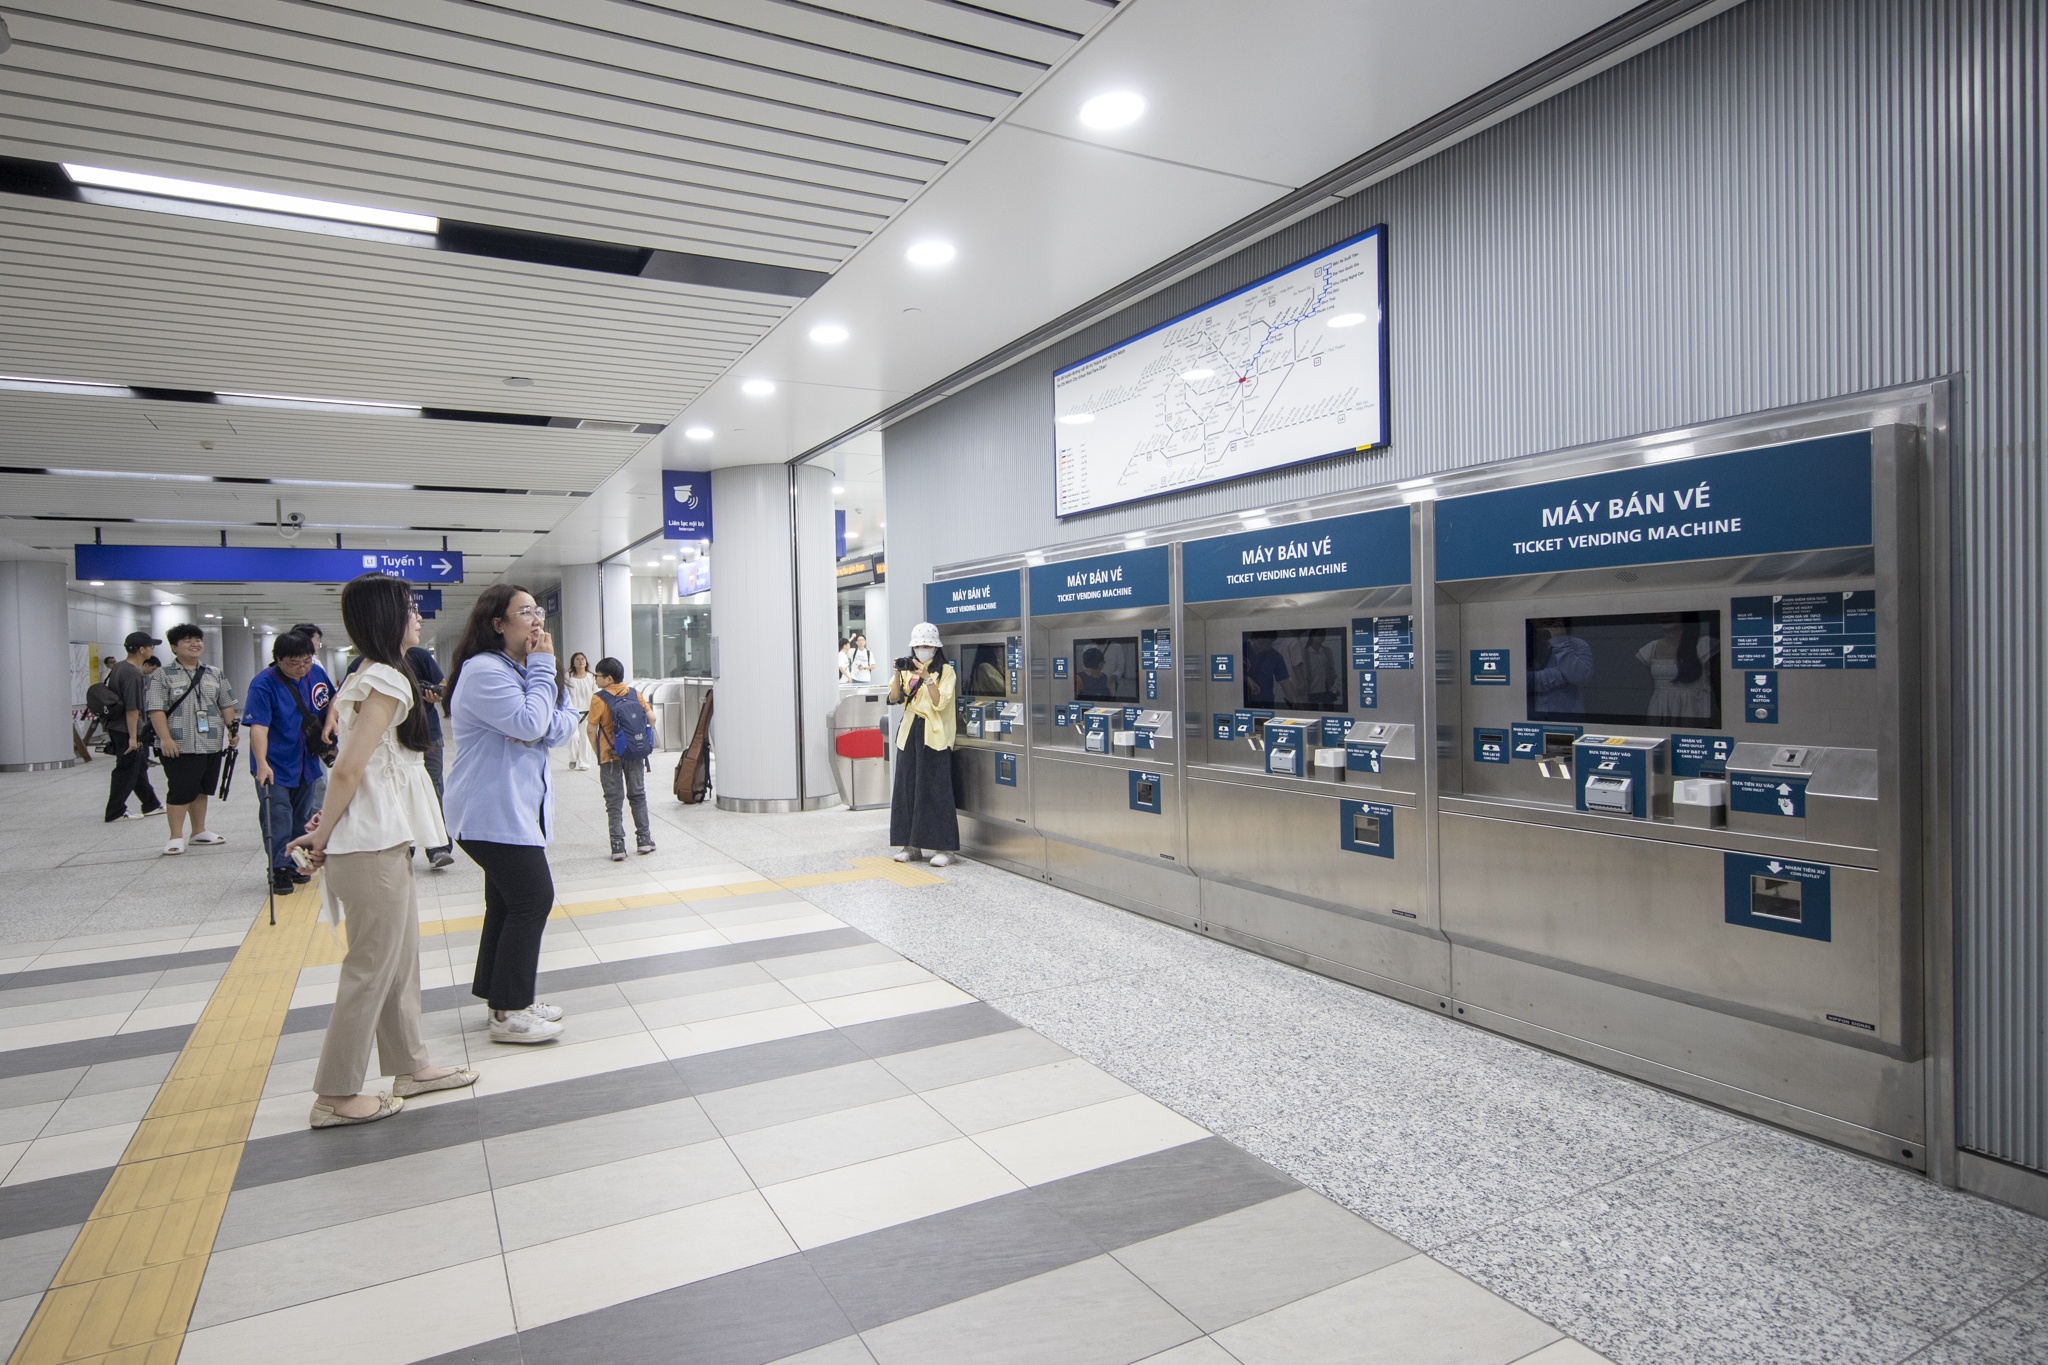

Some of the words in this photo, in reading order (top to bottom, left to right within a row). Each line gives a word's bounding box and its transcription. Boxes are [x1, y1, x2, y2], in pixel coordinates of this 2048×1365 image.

[1542, 500, 1600, 527] MÁY
[1608, 491, 1664, 520] BÁN
[1674, 481, 1710, 510] VÉ
[1513, 538, 1564, 554] TICKET
[1568, 529, 1642, 549] VENDING
[1648, 518, 1741, 540] MACHINE
[1242, 545, 1274, 565] MÁY
[1278, 541, 1308, 561] BÁN
[1312, 536, 1332, 555] VÉ
[381, 554, 415, 568] Tuyến
[418, 556, 423, 566] 1
[1067, 572, 1087, 587] MÁY
[1090, 569, 1108, 584] BÁN
[1110, 566, 1122, 581] VÉ
[1227, 572, 1255, 584] TICKET
[1256, 569, 1296, 581] VENDING
[1299, 562, 1347, 577] MACHINE
[952, 589, 966, 601] MÁY
[968, 587, 980, 600] BÁN
[982, 585, 990, 597] VÉ
[1058, 593, 1075, 602] TICKET
[1077, 591, 1101, 600] VENDING
[1102, 587, 1132, 597] MACHINE
[977, 602, 997, 610] MACHINE
[1828, 1015, 1850, 1024] NIPPON
[1851, 1021, 1872, 1030] SIGNAL
